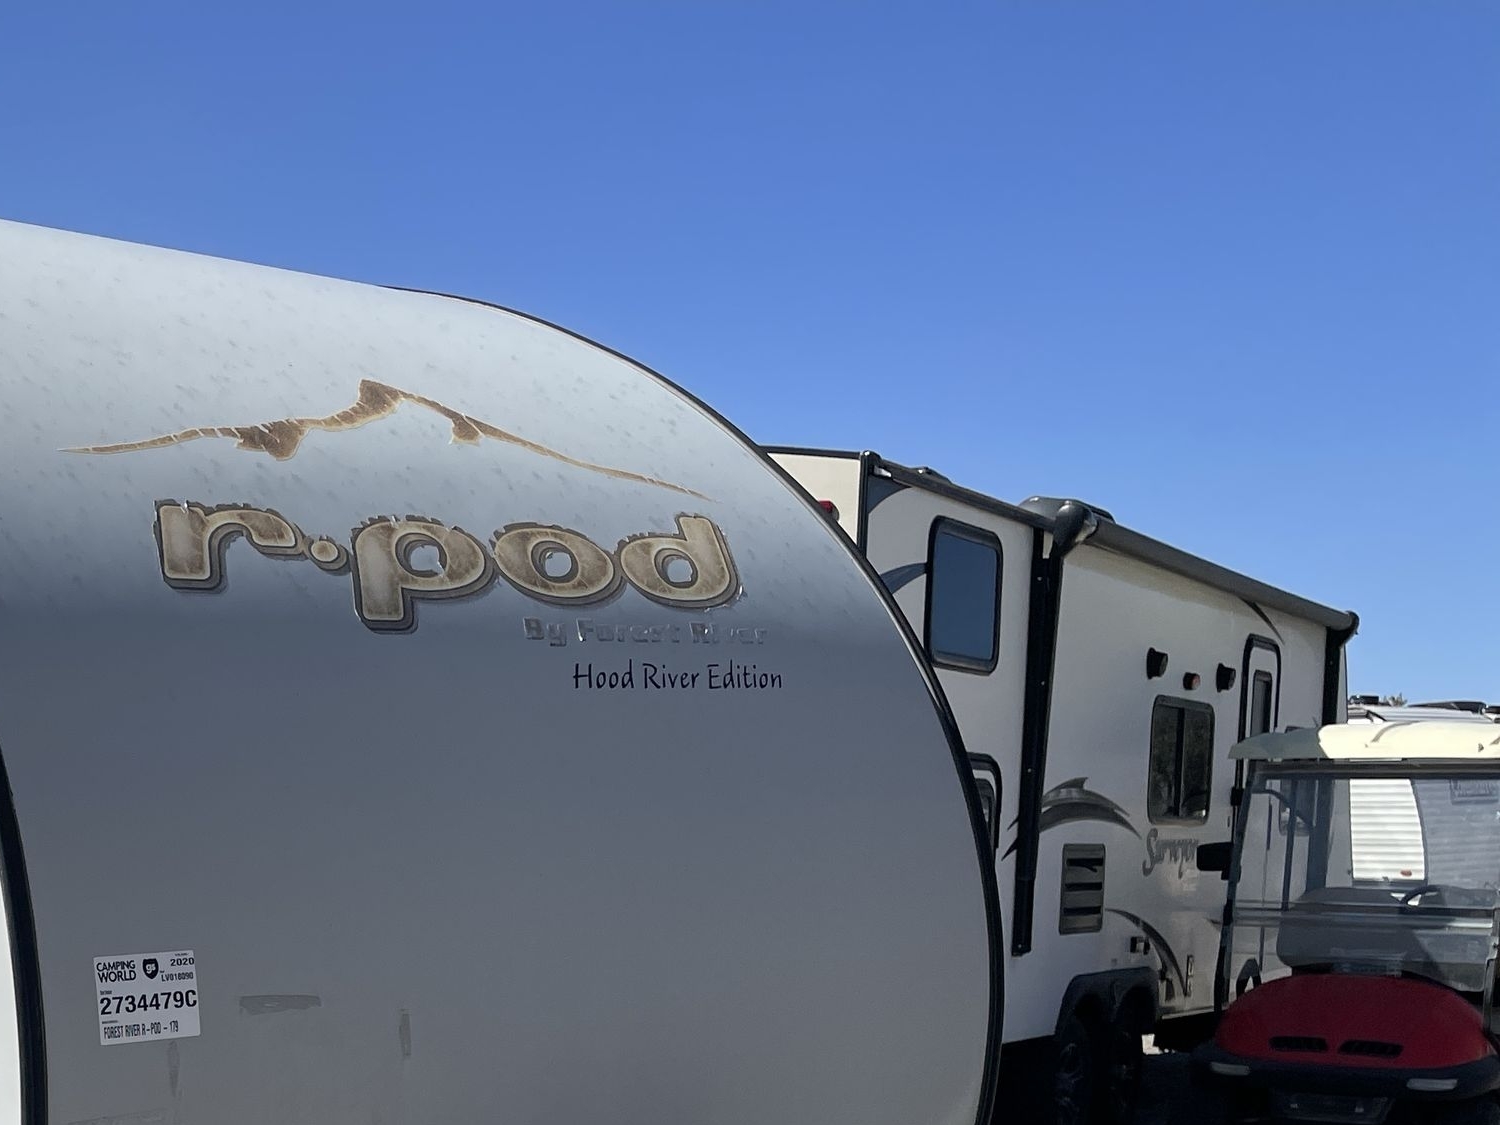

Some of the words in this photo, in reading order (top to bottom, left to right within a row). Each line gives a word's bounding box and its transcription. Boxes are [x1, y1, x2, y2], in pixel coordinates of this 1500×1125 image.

[523, 617, 567, 647] By
[689, 620, 768, 645] Rier
[573, 659, 635, 689] Hood
[642, 663, 699, 689] River
[707, 659, 782, 689] Edition
[96, 960, 136, 972] CAMPING
[170, 957, 195, 967] 2020
[97, 970, 137, 983] WORLD
[100, 989, 197, 1015] 2734479C
[103, 1025, 124, 1039] FOREST
[125, 1024, 141, 1037] RIVER
